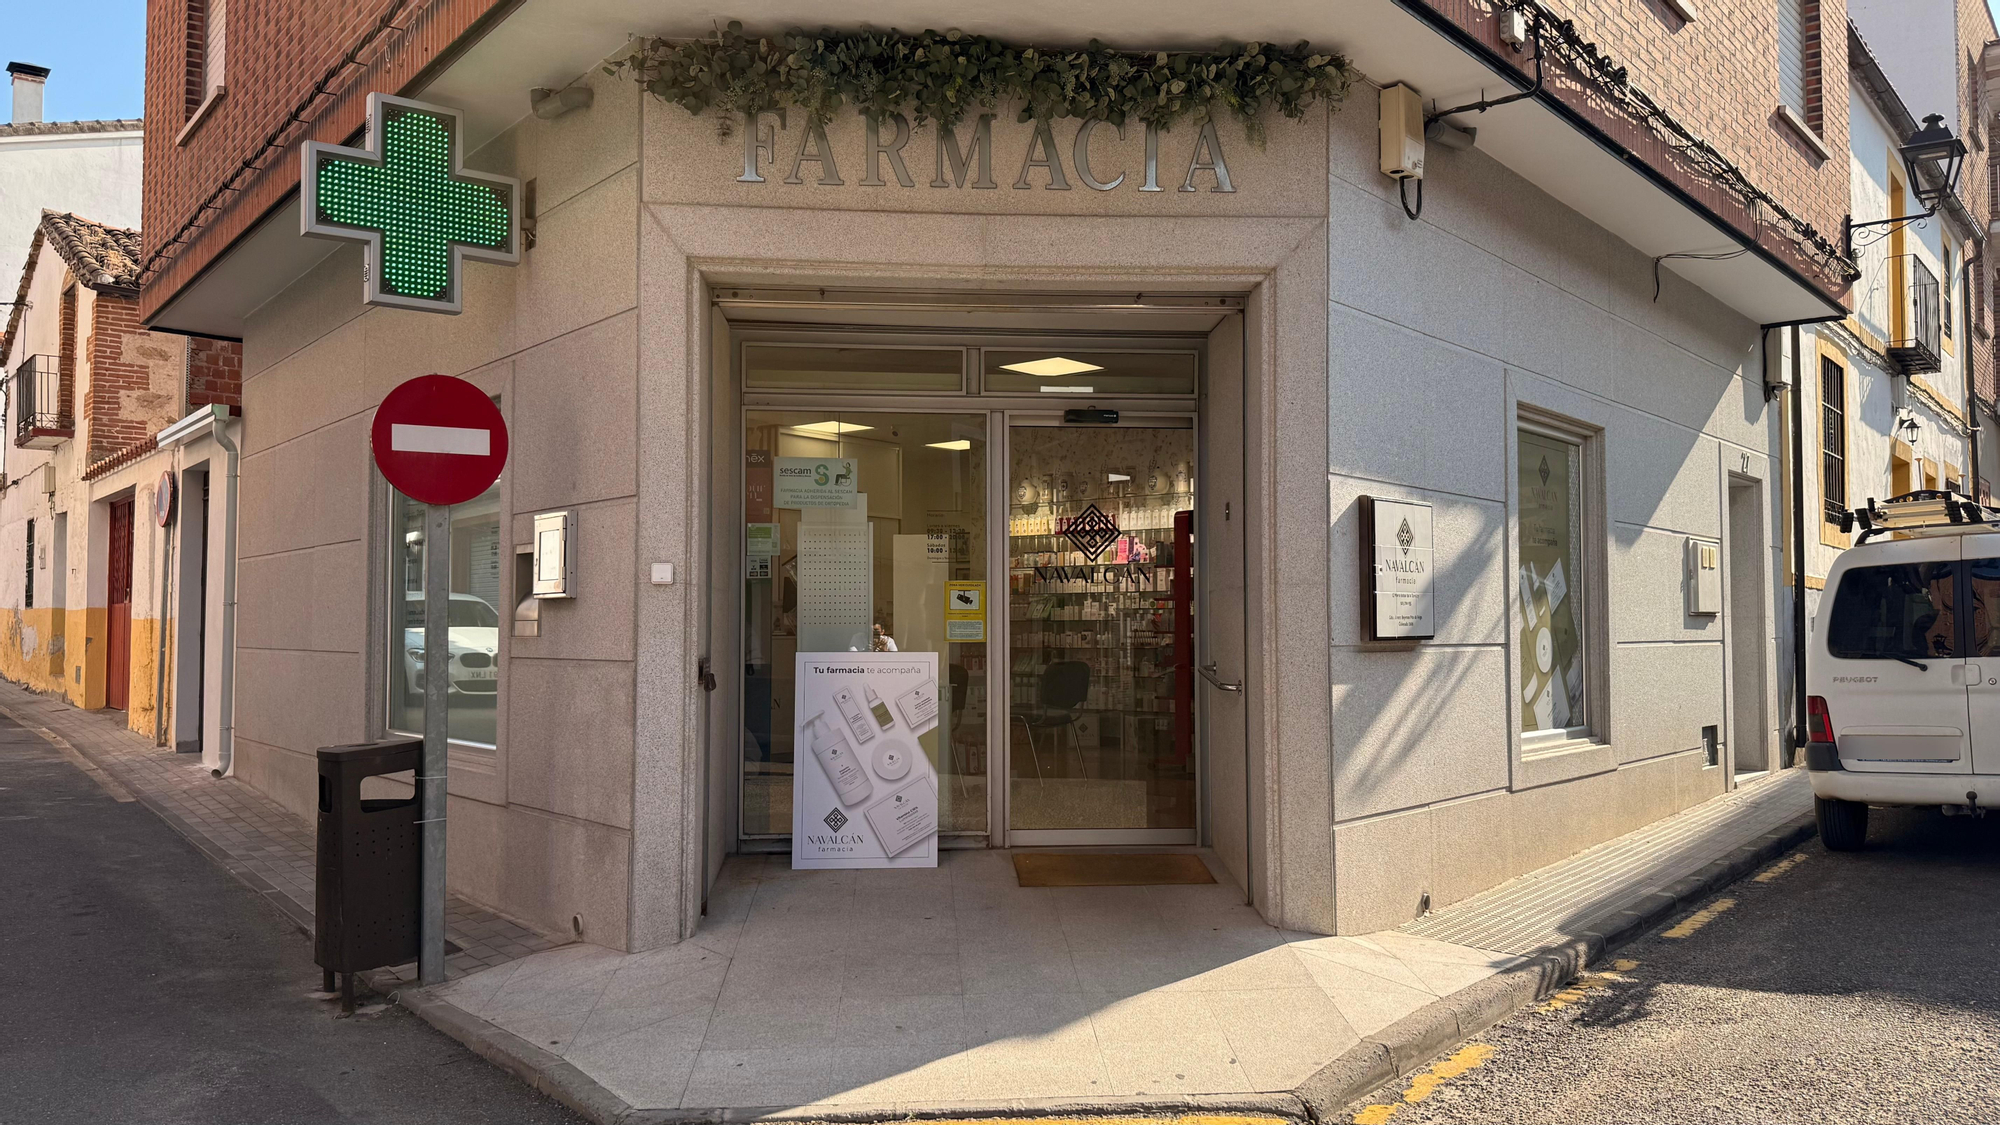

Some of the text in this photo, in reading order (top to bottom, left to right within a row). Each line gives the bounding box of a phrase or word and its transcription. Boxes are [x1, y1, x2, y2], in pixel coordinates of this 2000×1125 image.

[736, 107, 1237, 193] FARMACIA
[877, 667, 921, 675] acompaña
[807, 833, 864, 844] NAVALCÁN
